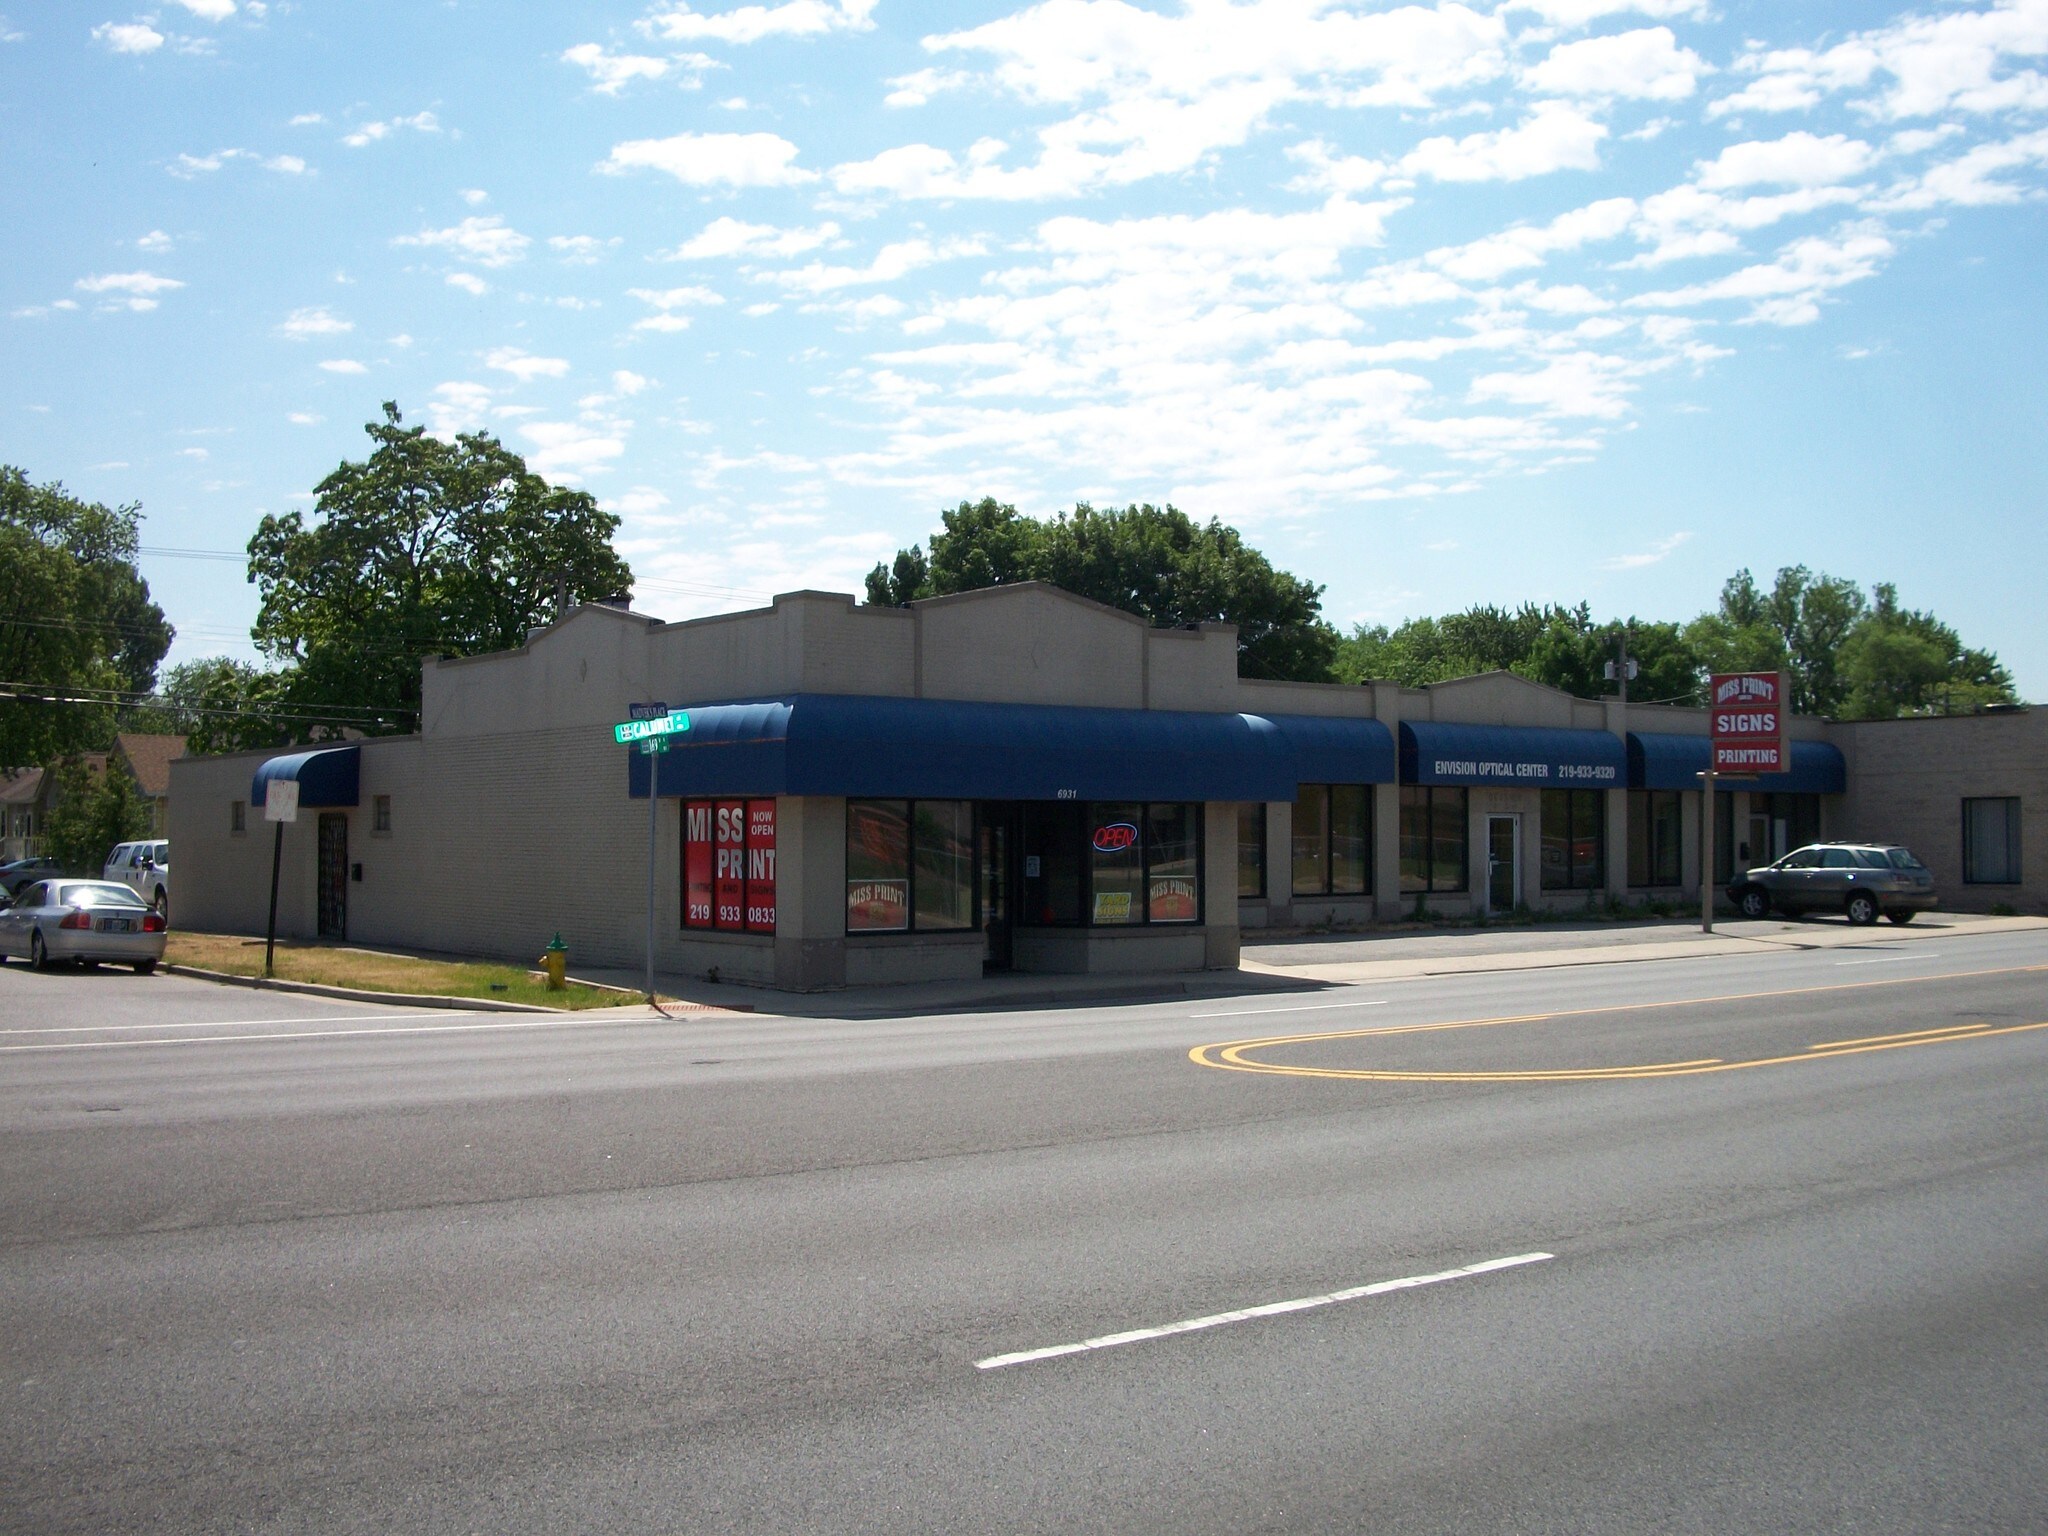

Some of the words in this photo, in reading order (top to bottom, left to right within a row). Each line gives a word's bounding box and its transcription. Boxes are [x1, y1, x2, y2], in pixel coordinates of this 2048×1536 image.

[1717, 678, 1739, 704] MISS
[1742, 677, 1774, 701] PRINT
[633, 715, 674, 738] CALUMET
[1717, 713, 1775, 732] SIGNS
[1717, 749, 1778, 764] PRINTING
[1435, 760, 1476, 776] ENVISION
[1478, 762, 1514, 777] OPTICAL
[1516, 763, 1548, 777] CENTER
[1558, 765, 1615, 780] 219-933-9320
[1057, 789, 1077, 799] 6931
[687, 807, 743, 843] MISS
[752, 811, 773, 822] NOW
[751, 824, 774, 836] OPEN
[1094, 827, 1135, 847] OPEN
[717, 848, 776, 881] PRINT
[848, 885, 872, 909] MISS
[874, 884, 905, 907] PRINT
[1099, 894, 1129, 905] YARD
[1150, 880, 1168, 901] MISS
[1170, 880, 1194, 900] PRINT
[690, 904, 710, 920] 219
[720, 905, 741, 922] 933
[748, 906, 776, 924] 0833
[1096, 905, 1128, 917] SIGNS
